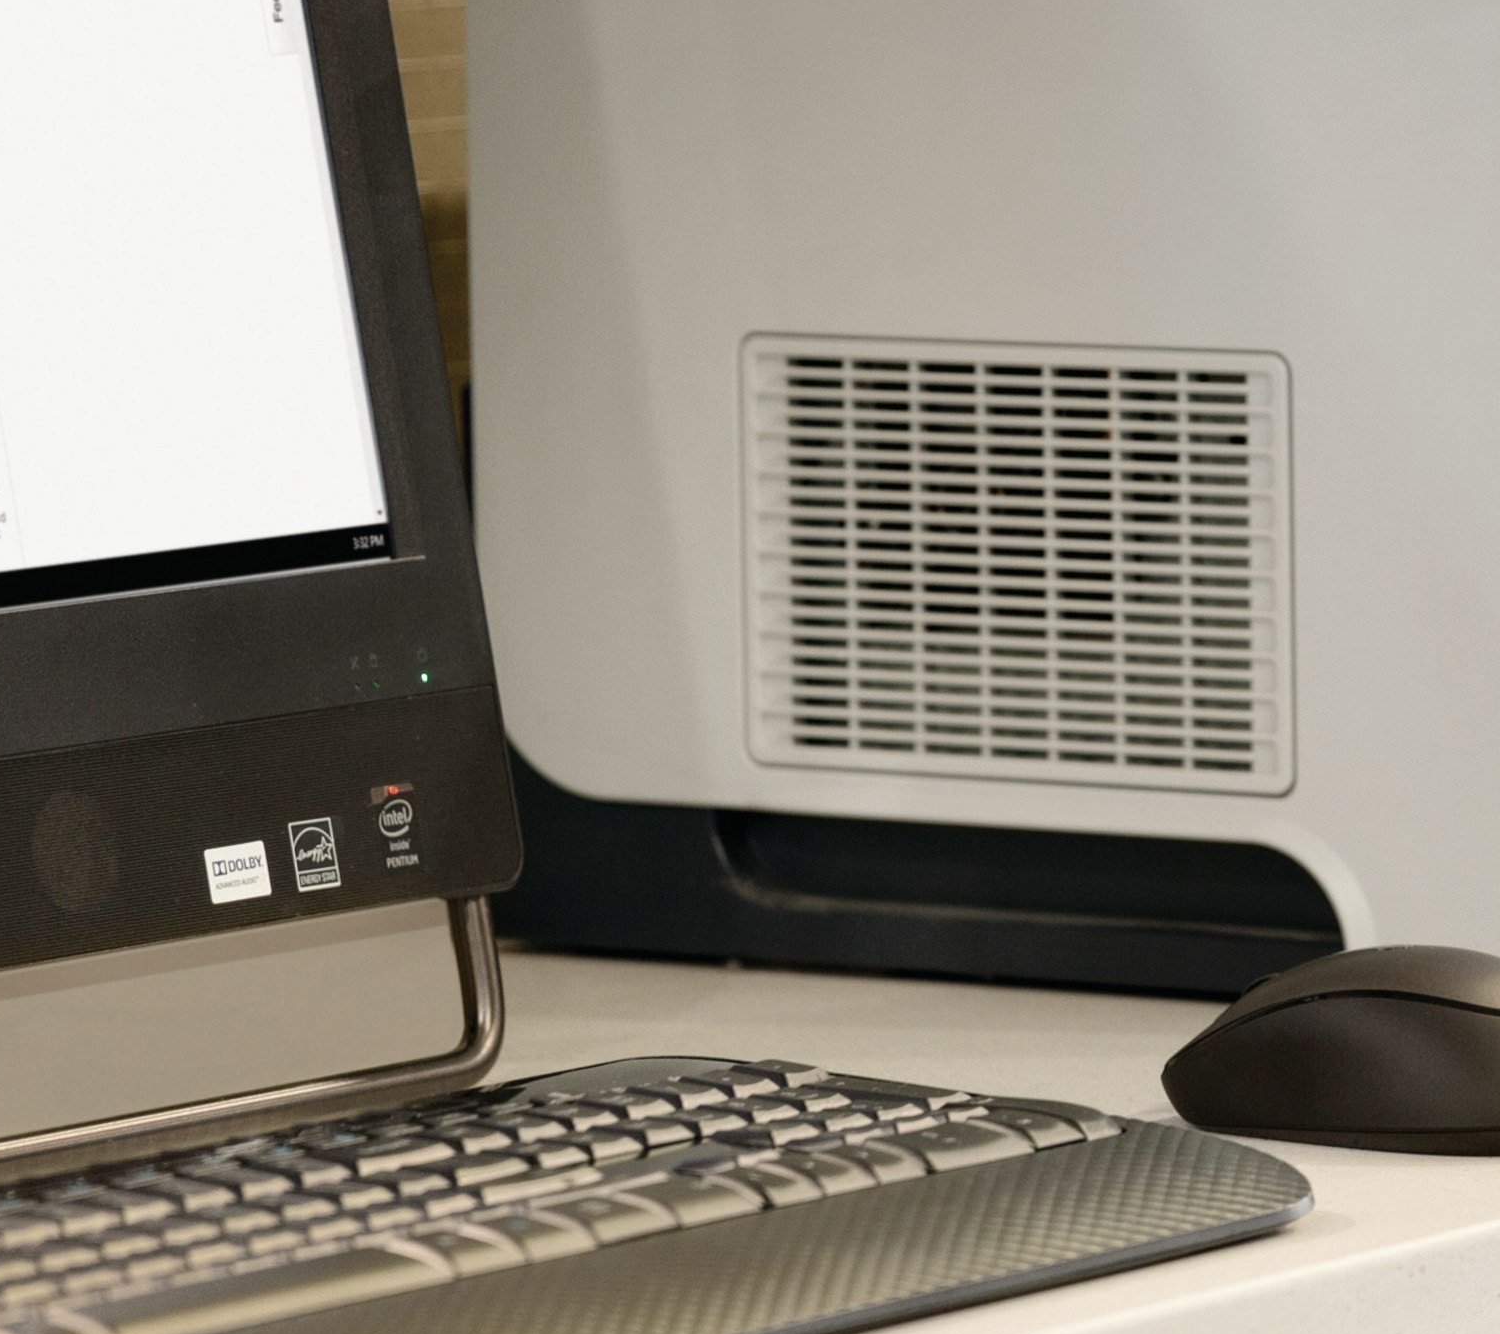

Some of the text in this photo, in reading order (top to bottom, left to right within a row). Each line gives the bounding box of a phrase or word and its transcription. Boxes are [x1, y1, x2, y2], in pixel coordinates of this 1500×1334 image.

[228, 855, 262, 873] DOLBY
[386, 853, 419, 869] PENTIUM
[300, 870, 337, 886] ENERGY STAR
